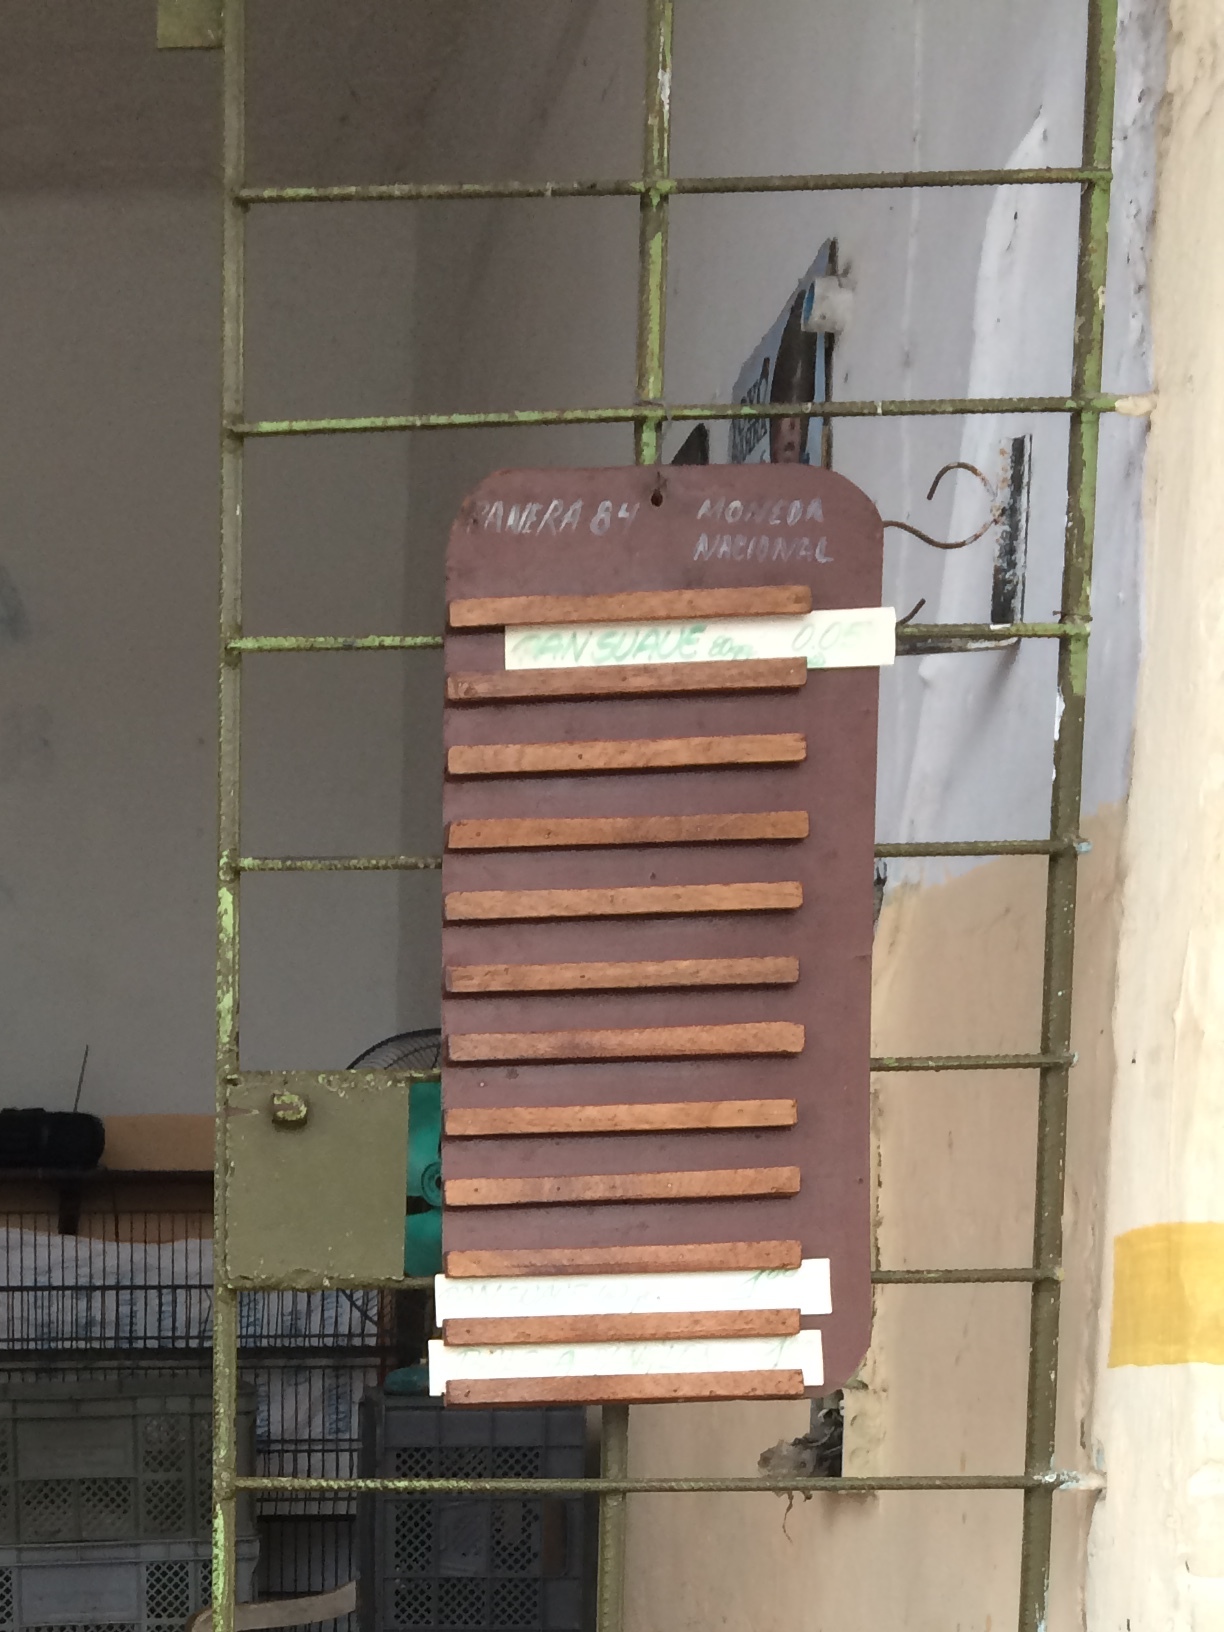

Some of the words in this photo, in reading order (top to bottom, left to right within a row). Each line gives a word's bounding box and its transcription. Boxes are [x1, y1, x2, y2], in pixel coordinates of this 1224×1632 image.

[466, 497, 584, 536] PANERA
[589, 499, 641, 536] 84
[696, 497, 824, 526] MONEDA
[692, 532, 835, 563] NACIONAL
